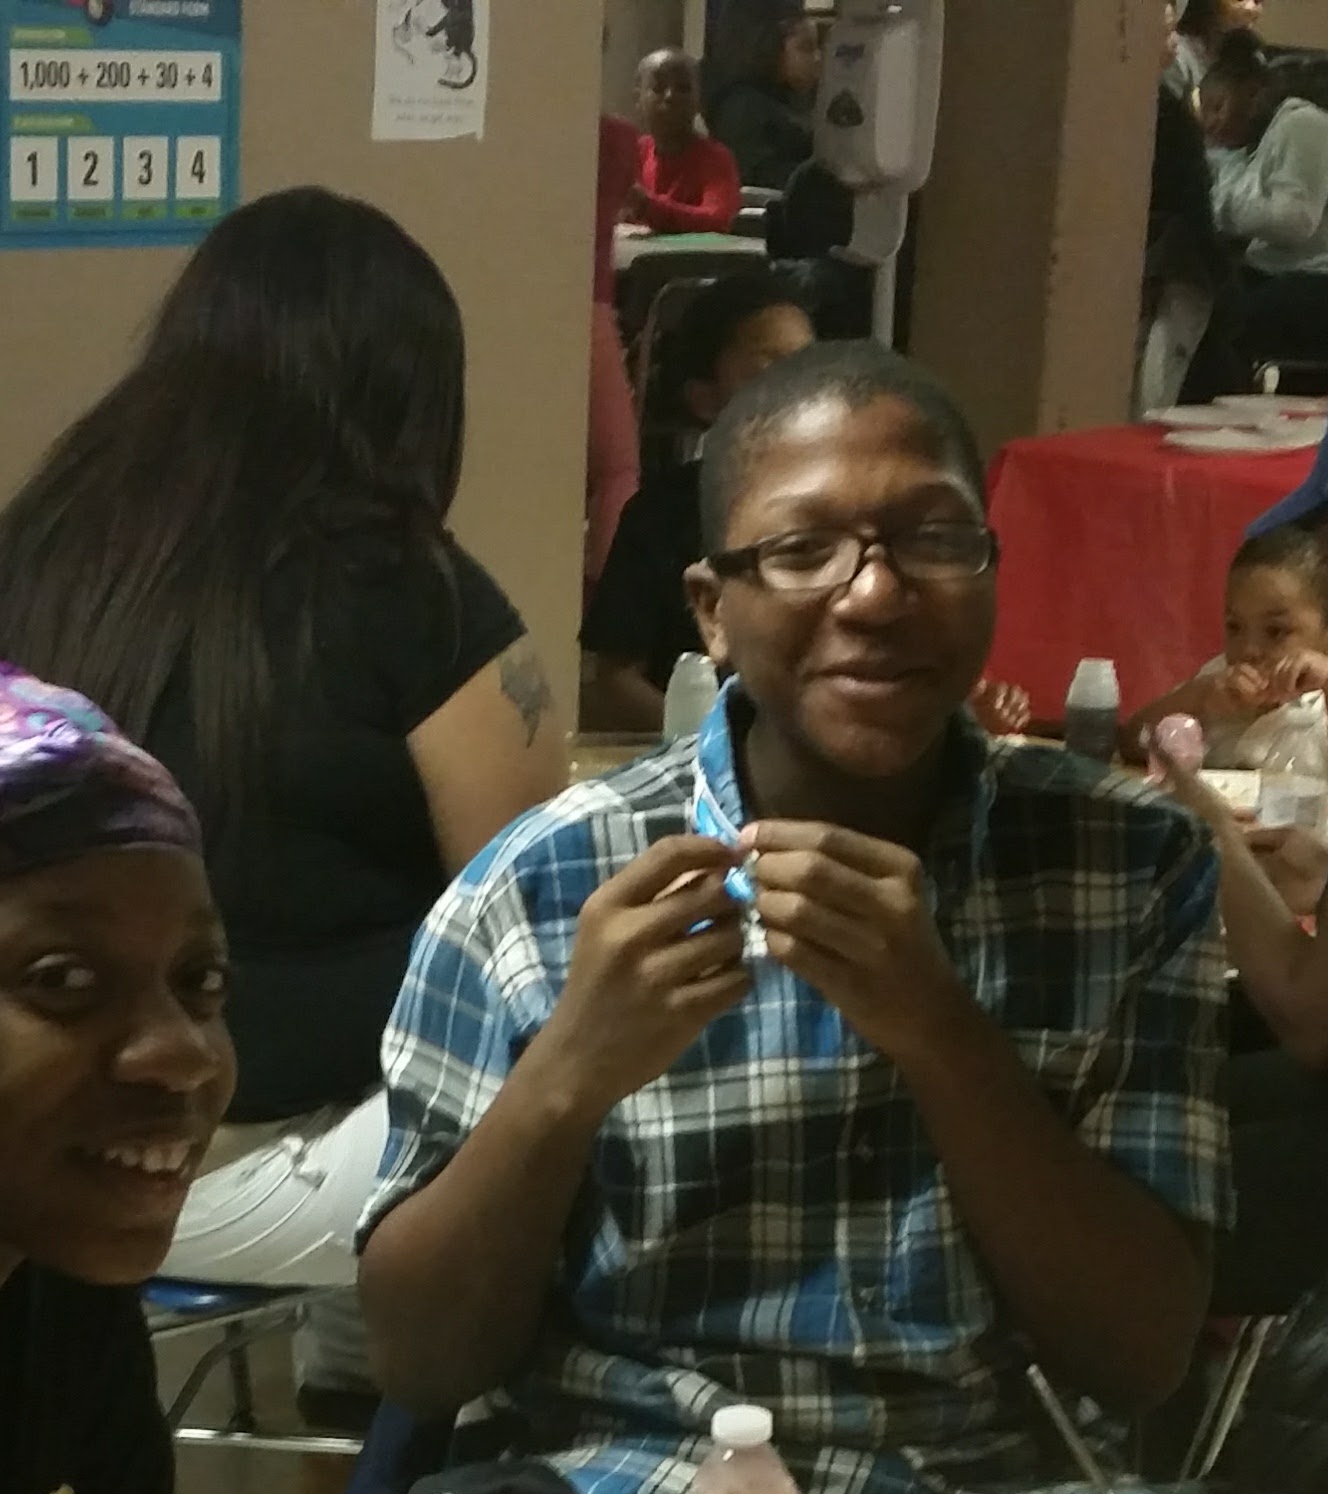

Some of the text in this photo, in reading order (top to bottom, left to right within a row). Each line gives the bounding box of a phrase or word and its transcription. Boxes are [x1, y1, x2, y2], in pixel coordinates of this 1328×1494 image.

[20, 60, 71, 91] 1,000
[96, 61, 131, 89] 200
[156, 61, 179, 89] 30
[201, 63, 213, 88] 4
[27, 150, 206, 187] 1 2 3 4
